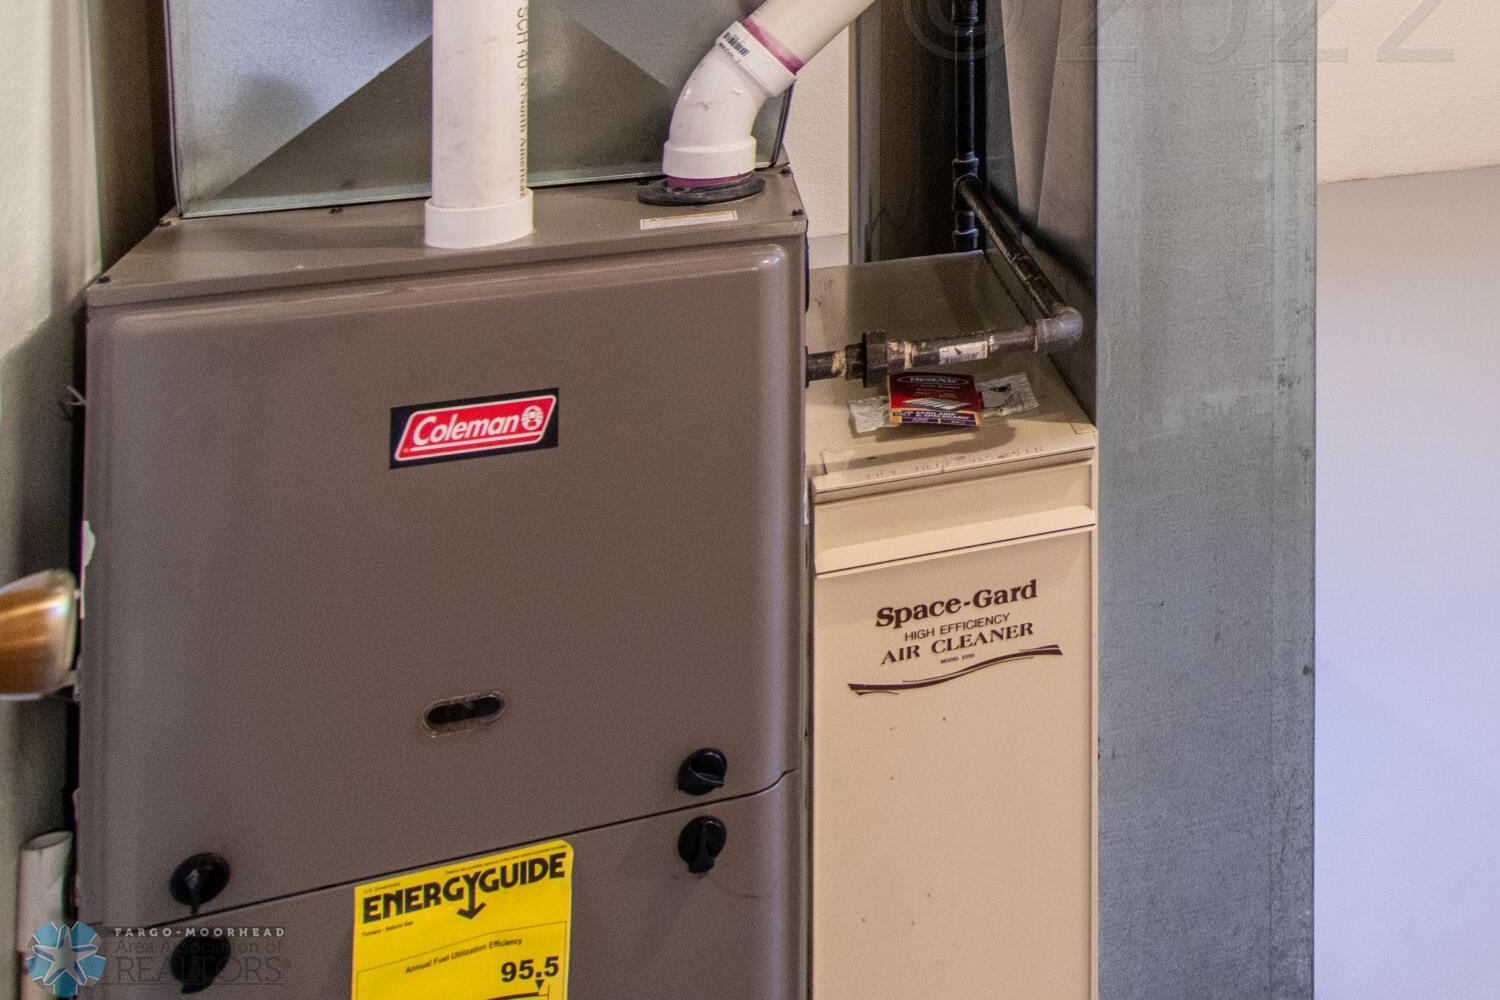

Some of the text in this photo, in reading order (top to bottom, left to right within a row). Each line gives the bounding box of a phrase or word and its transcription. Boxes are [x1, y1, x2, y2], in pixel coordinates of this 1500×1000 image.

[516, 48, 529, 69] 40
[413, 414, 519, 446] Coleman
[875, 579, 1038, 630] Space-Gard
[881, 622, 1034, 666] AIR CLEANER
[904, 613, 1010, 642] HIGH EFFICIENCY
[363, 851, 566, 924] ENERGYGUIDE
[405, 937, 523, 975] Annual Fuel Utilization Efficiency
[500, 955, 560, 983] 95.5
